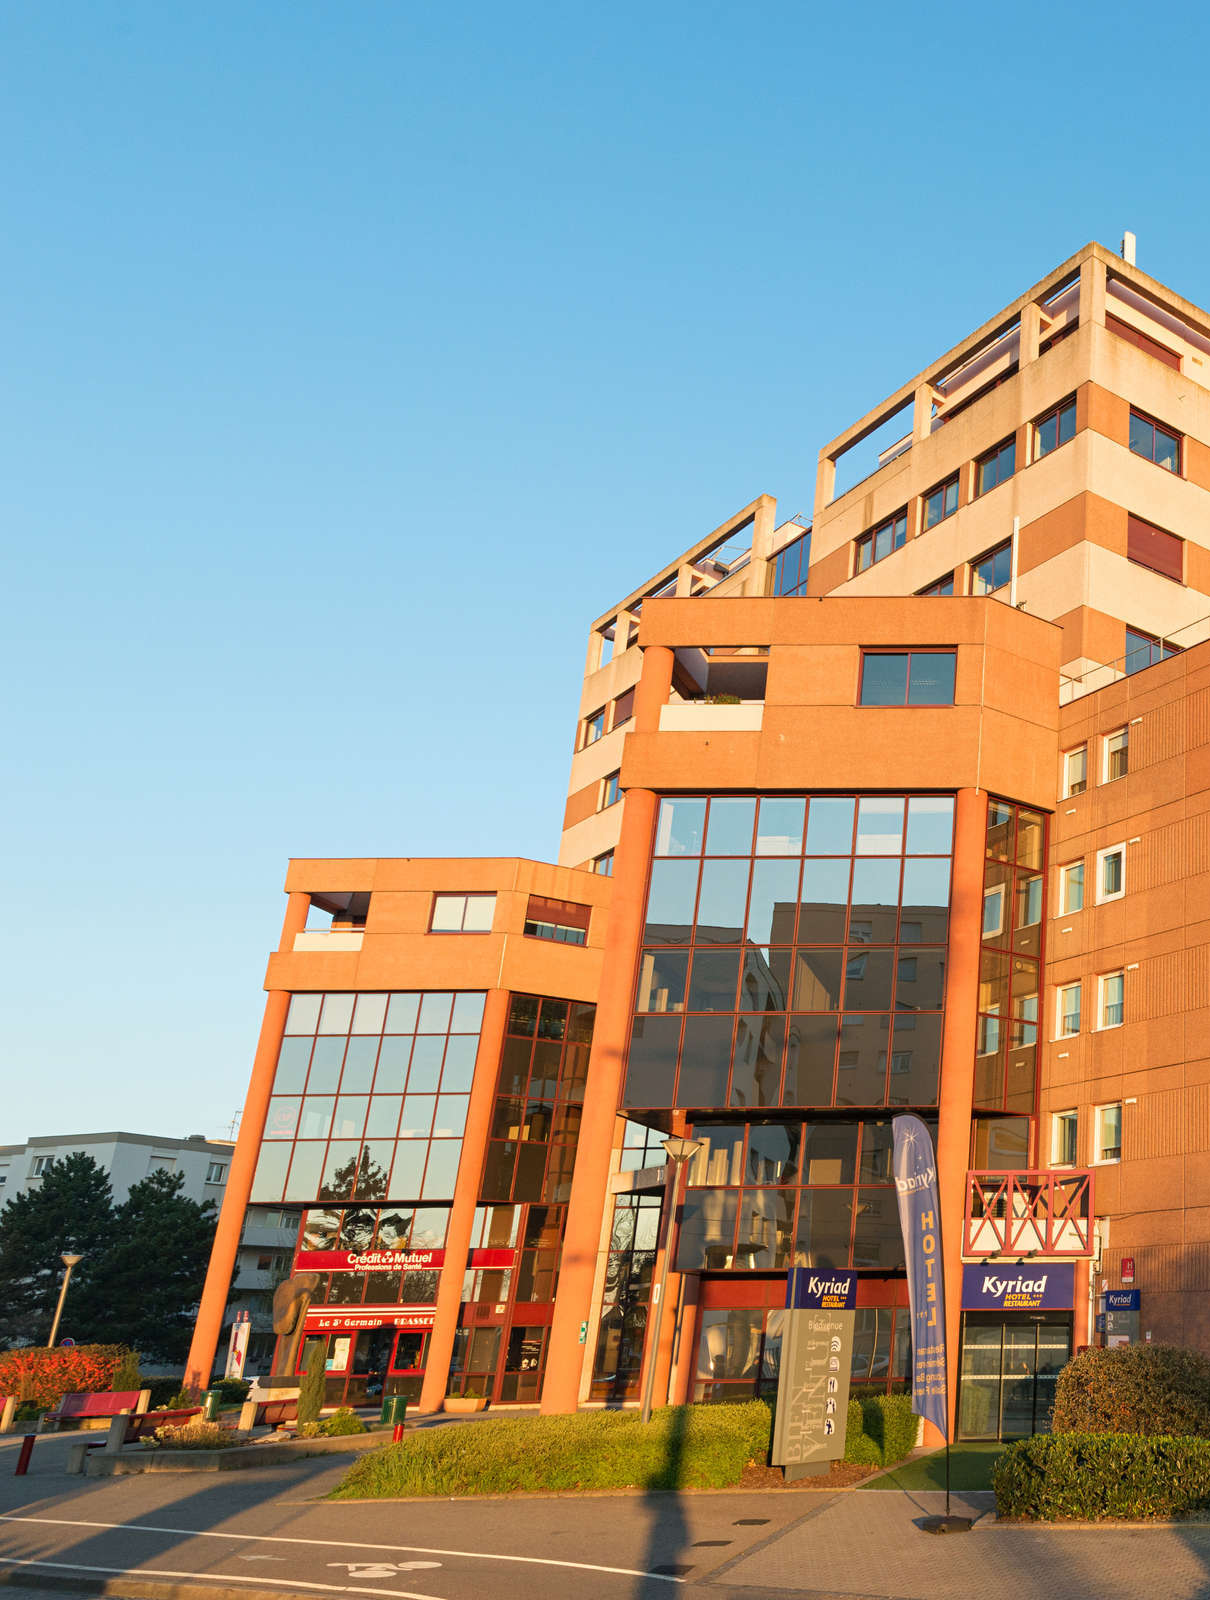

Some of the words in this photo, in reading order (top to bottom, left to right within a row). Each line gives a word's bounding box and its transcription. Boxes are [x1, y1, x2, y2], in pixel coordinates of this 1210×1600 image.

[347, 1252, 382, 1264] Crédit
[394, 1252, 433, 1264] Mutuel
[354, 1263, 393, 1271] Professions
[807, 1276, 851, 1298] Kyriad
[981, 1275, 1048, 1298] Kyriad
[1003, 1300, 1041, 1308] RESTAURANT
[1108, 1294, 1132, 1306] Kyriad
[318, 1319, 330, 1328] Le
[344, 1318, 383, 1327] Germain
